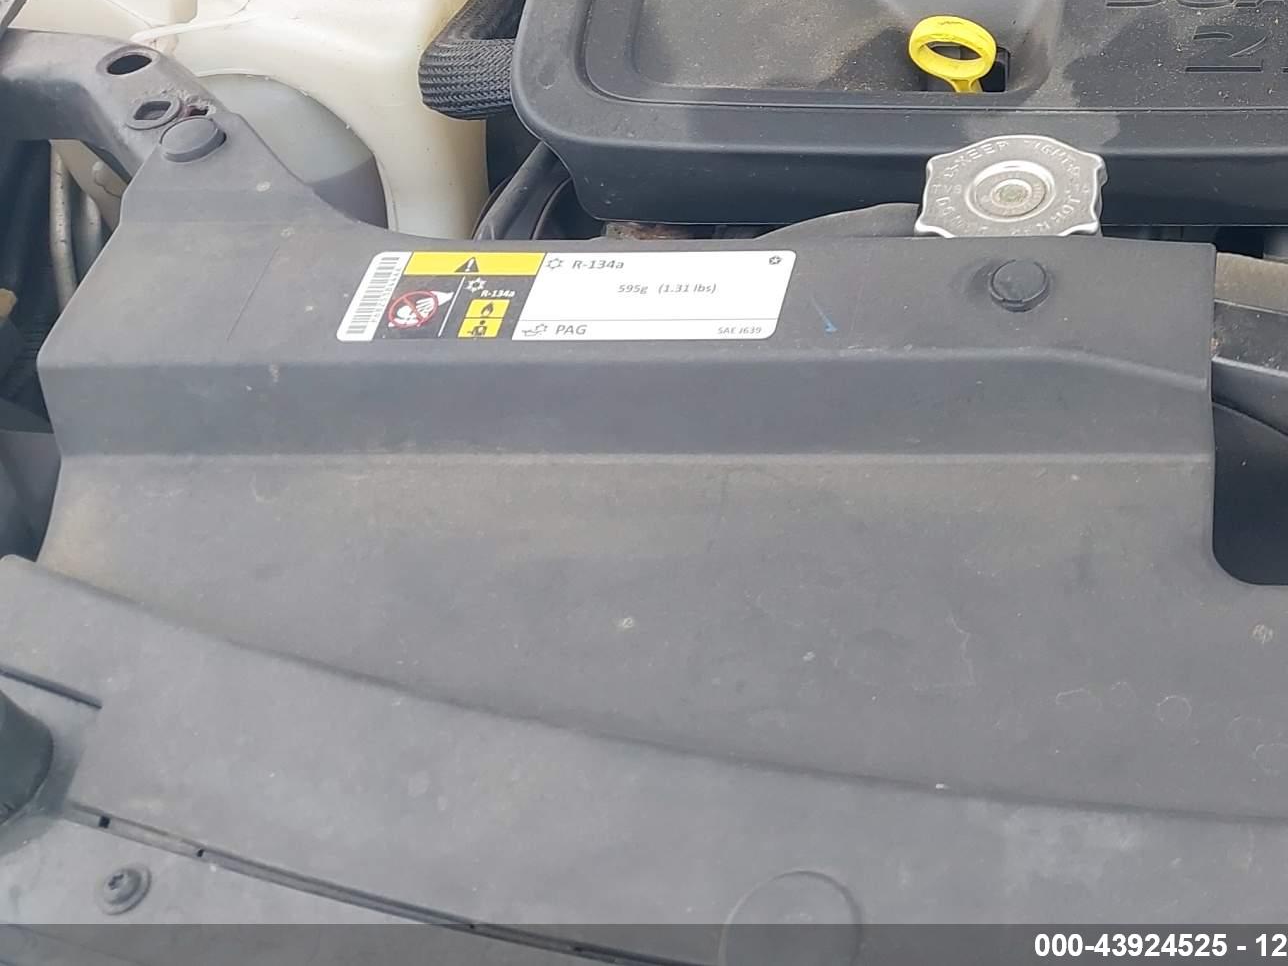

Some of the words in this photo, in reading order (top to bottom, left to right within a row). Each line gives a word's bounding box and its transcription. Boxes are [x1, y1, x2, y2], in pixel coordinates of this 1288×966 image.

[571, 260, 625, 270] R-134a
[480, 289, 516, 298] R-134a
[617, 284, 648, 295] 595g
[657, 283, 690, 295] (1.31
[693, 283, 717, 294] lbs)
[555, 324, 588, 336] PAG
